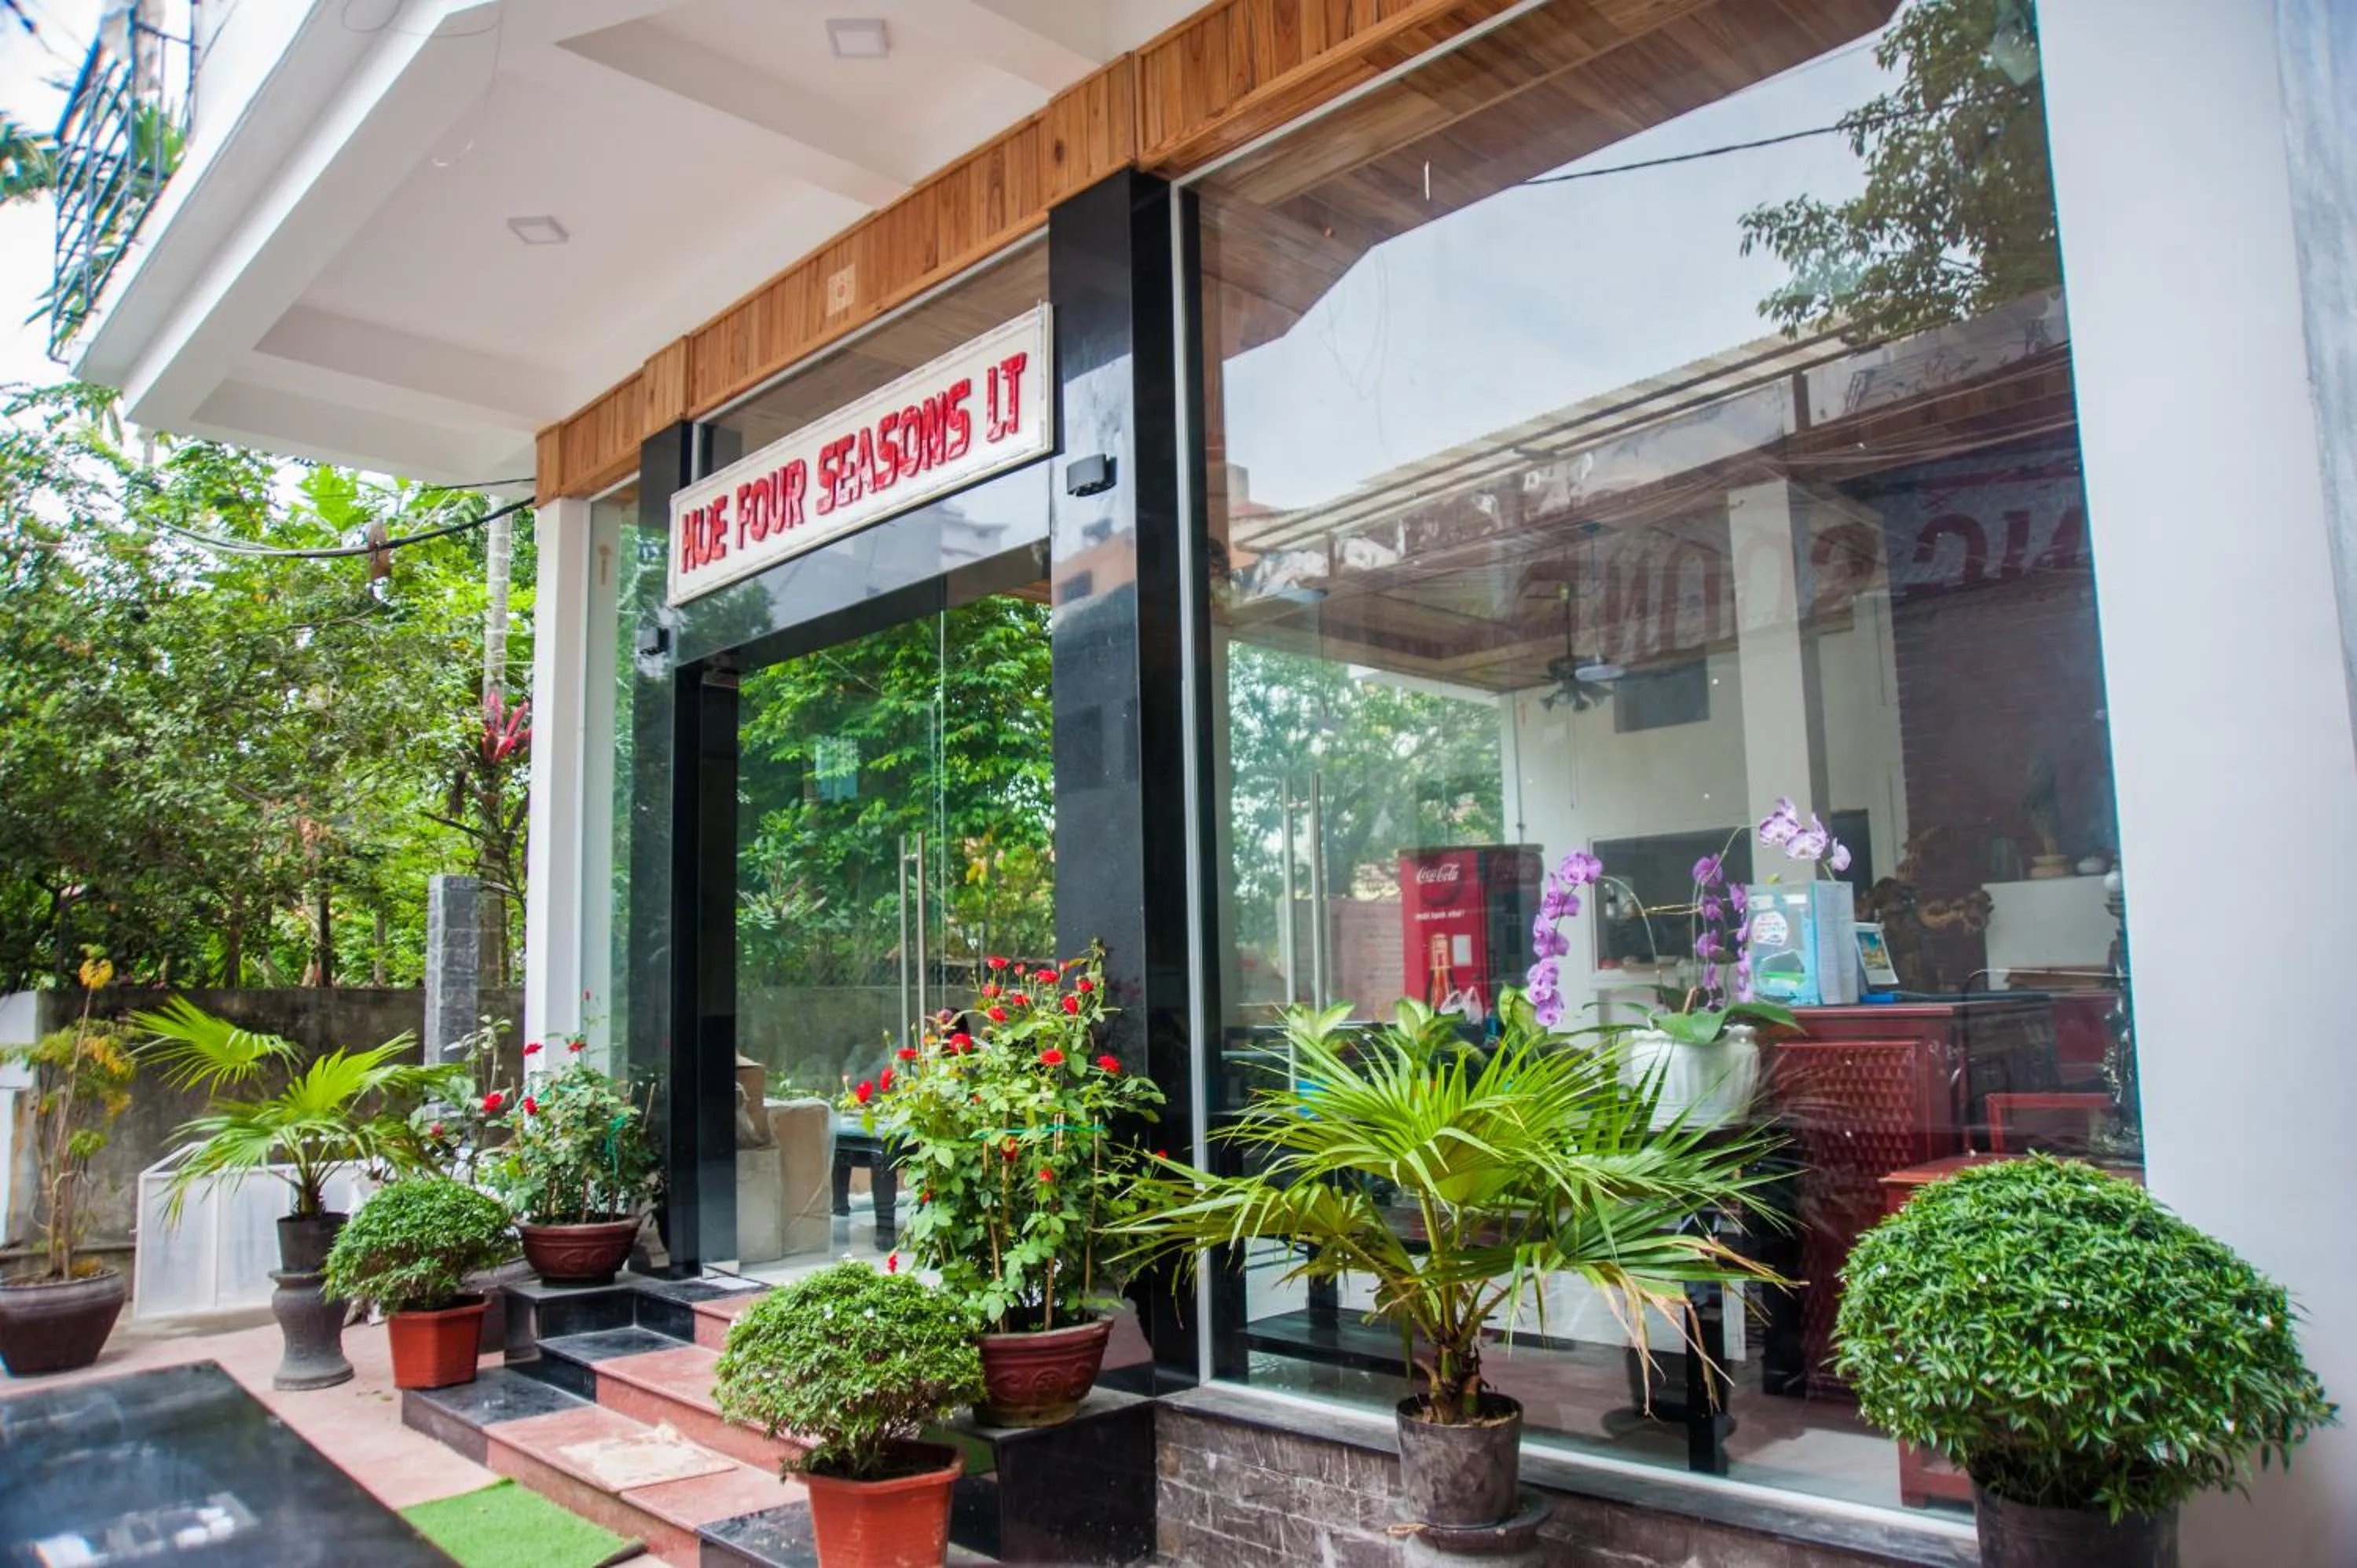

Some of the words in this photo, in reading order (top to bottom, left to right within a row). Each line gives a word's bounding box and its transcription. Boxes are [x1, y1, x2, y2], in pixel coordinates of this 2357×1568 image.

[682, 496, 728, 573] HUE
[736, 459, 806, 549] FOUR
[816, 379, 971, 515] SEASONS
[987, 352, 1028, 443] LT
